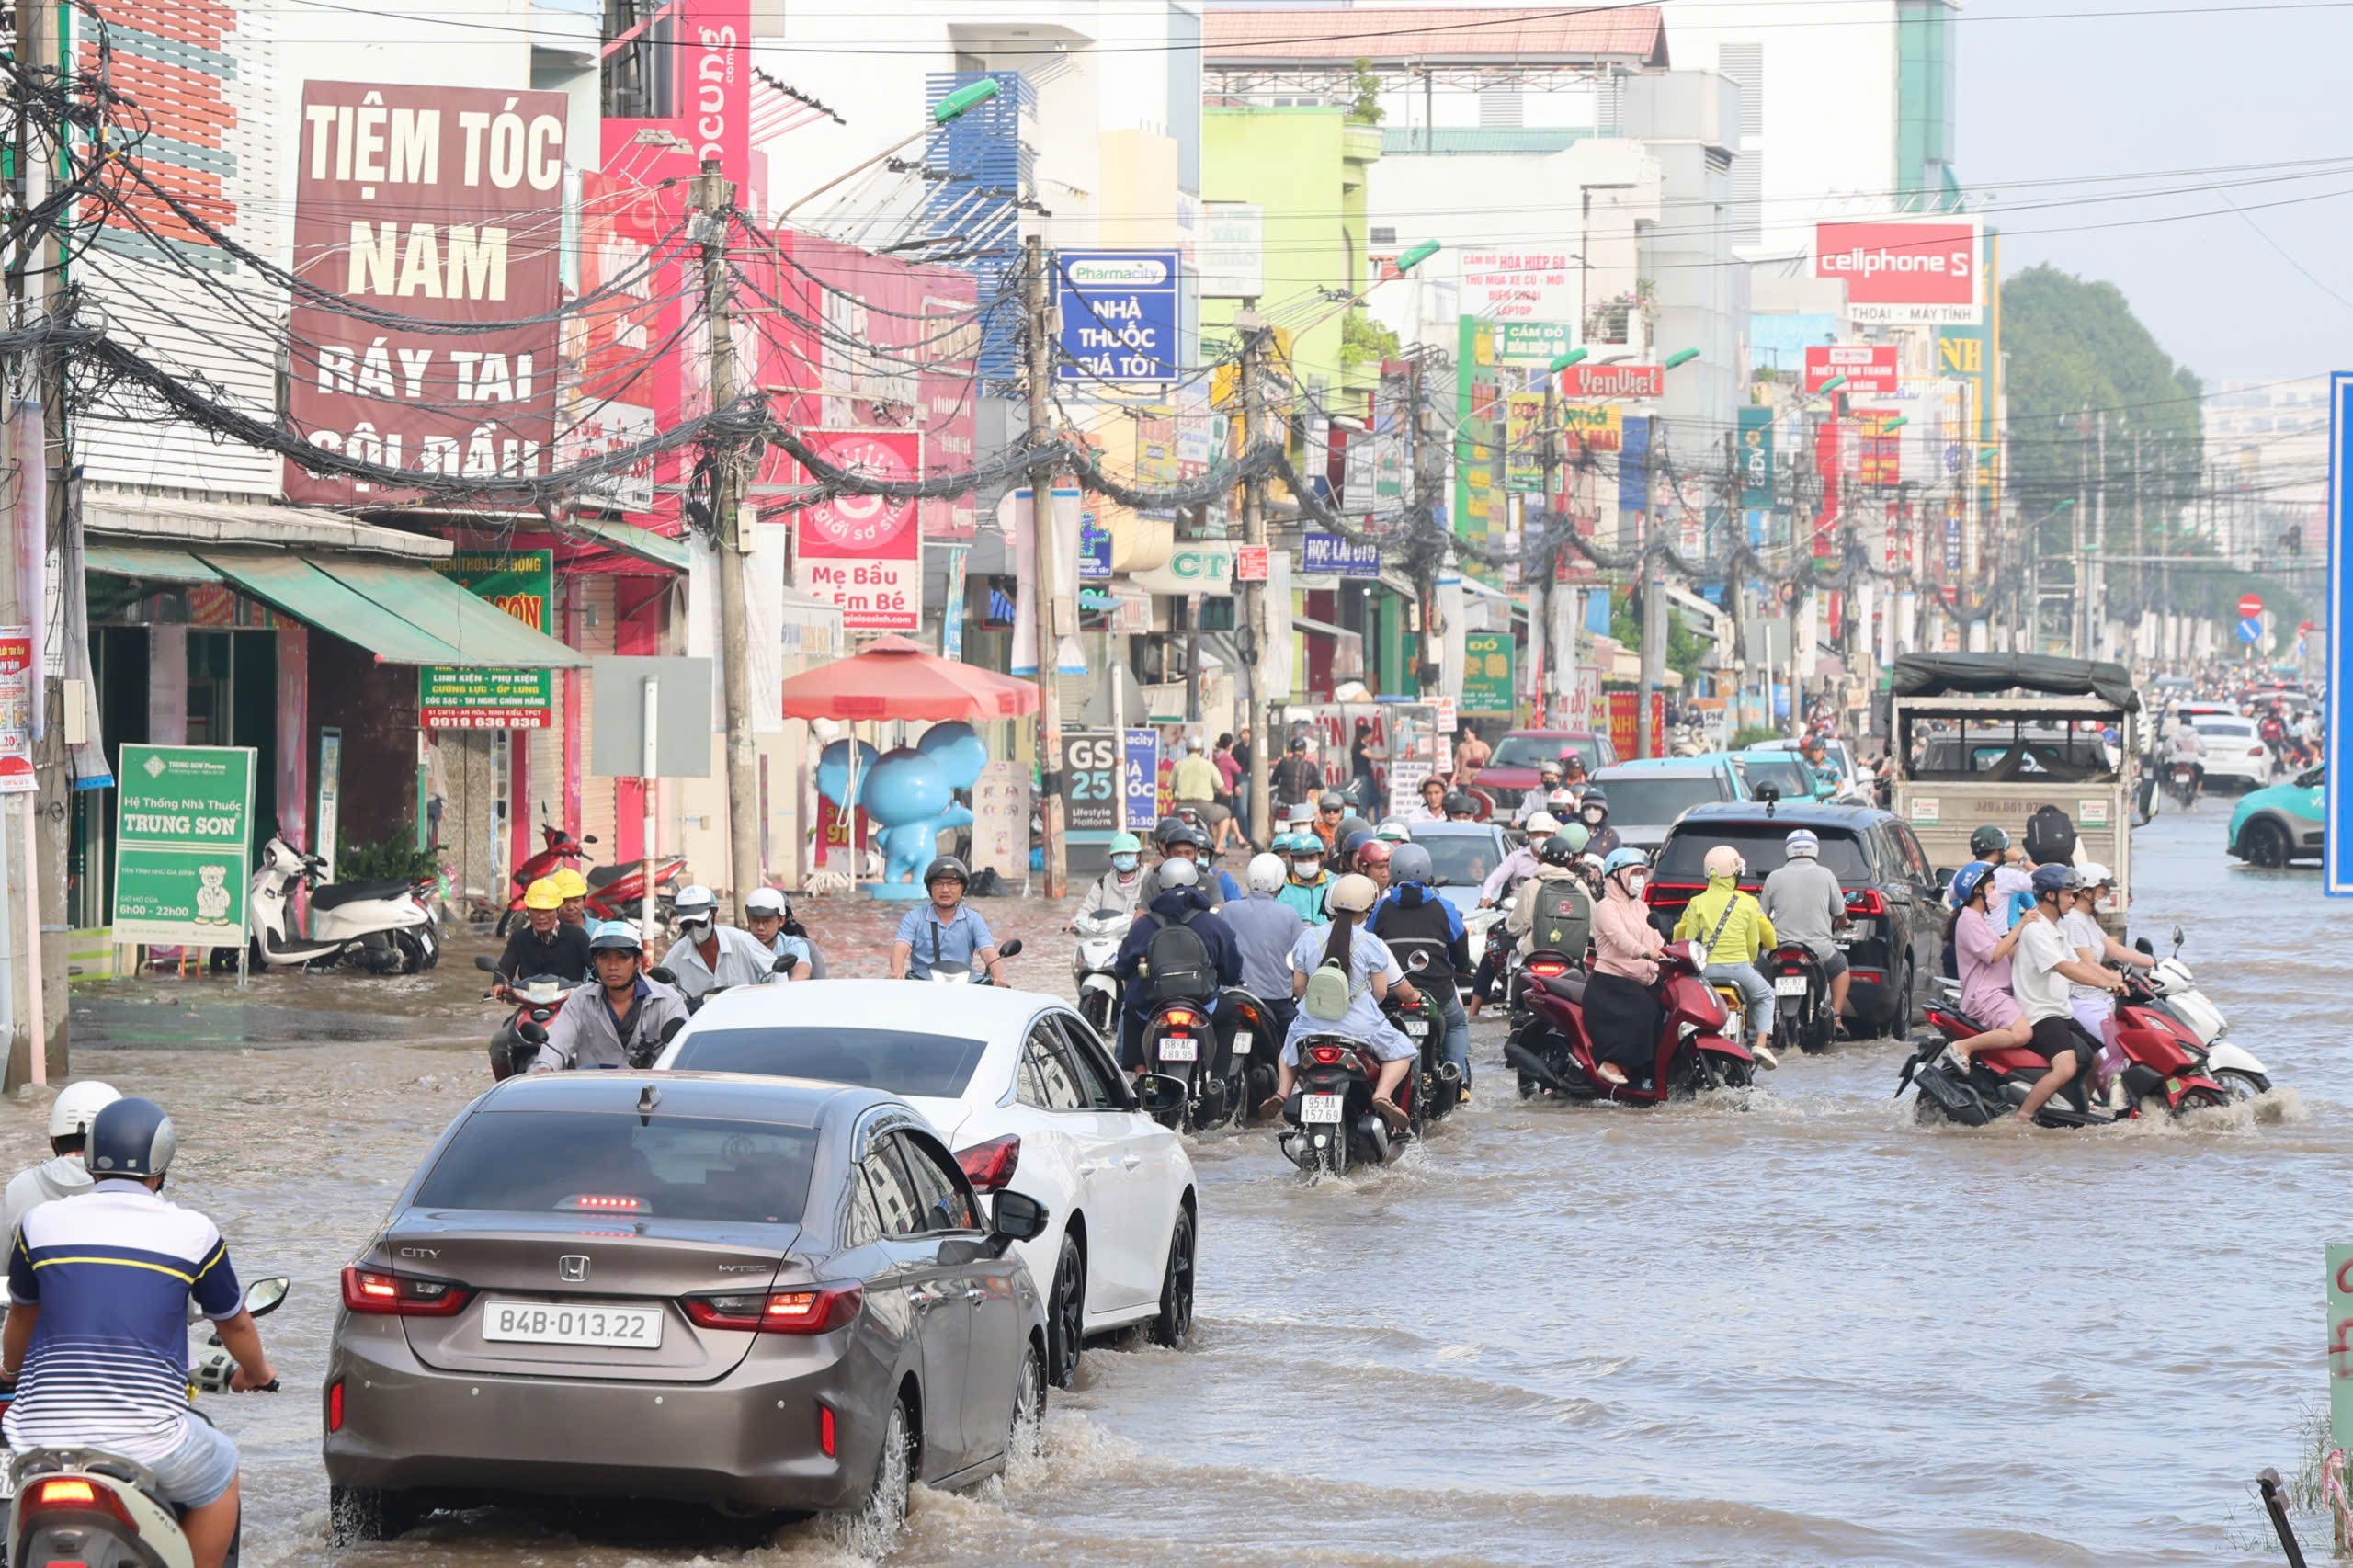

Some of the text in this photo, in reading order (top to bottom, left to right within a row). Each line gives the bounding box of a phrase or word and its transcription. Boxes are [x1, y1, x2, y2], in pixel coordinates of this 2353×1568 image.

[305, 90, 563, 199] TIỆM TÓC
[347, 221, 507, 301] NAM
[1552, 256, 1566, 268] 68
[1076, 263, 1158, 282] Pharmacity
[1465, 275, 1483, 285] THU
[1485, 275, 1506, 285] MUA
[1509, 275, 1521, 285] XE
[1092, 296, 1142, 319] NHÀ
[1497, 306, 1532, 315] LAPTOP
[1910, 304, 1938, 319] MÁY
[1942, 304, 1972, 319] TÍNH
[1078, 321, 1155, 347] THUỐC
[317, 337, 532, 403] RÁY TAI
[1076, 348, 1161, 377] GIÁ TỐT
[1307, 539, 1330, 565] HỌC
[1170, 551, 1229, 580] CT
[812, 562, 898, 589] Mẹ Bầu
[876, 591, 905, 610] Bé
[433, 674, 538, 684] LINH KIỆN PHỤ KIỆN
[442, 697, 458, 705] SẠC
[464, 697, 476, 705] TAI
[477, 697, 497, 705] NGHE
[429, 717, 540, 727] 0919 636 838
[1068, 739, 1114, 769] GS
[1071, 770, 1112, 800] 25
[124, 796, 242, 812] Hệ Thống Nhà Thuốc
[1072, 808, 1111, 818] Lifestyle
[124, 813, 191, 835] TRUNG
[1072, 817, 1111, 826] Platform
[119, 904, 189, 917] 6h00 22h00
[1308, 1096, 1336, 1108] 95-AA
[1304, 1109, 1338, 1120] 157.69
[401, 1247, 441, 1259] CITY
[499, 1309, 645, 1339] 84B-013.22
